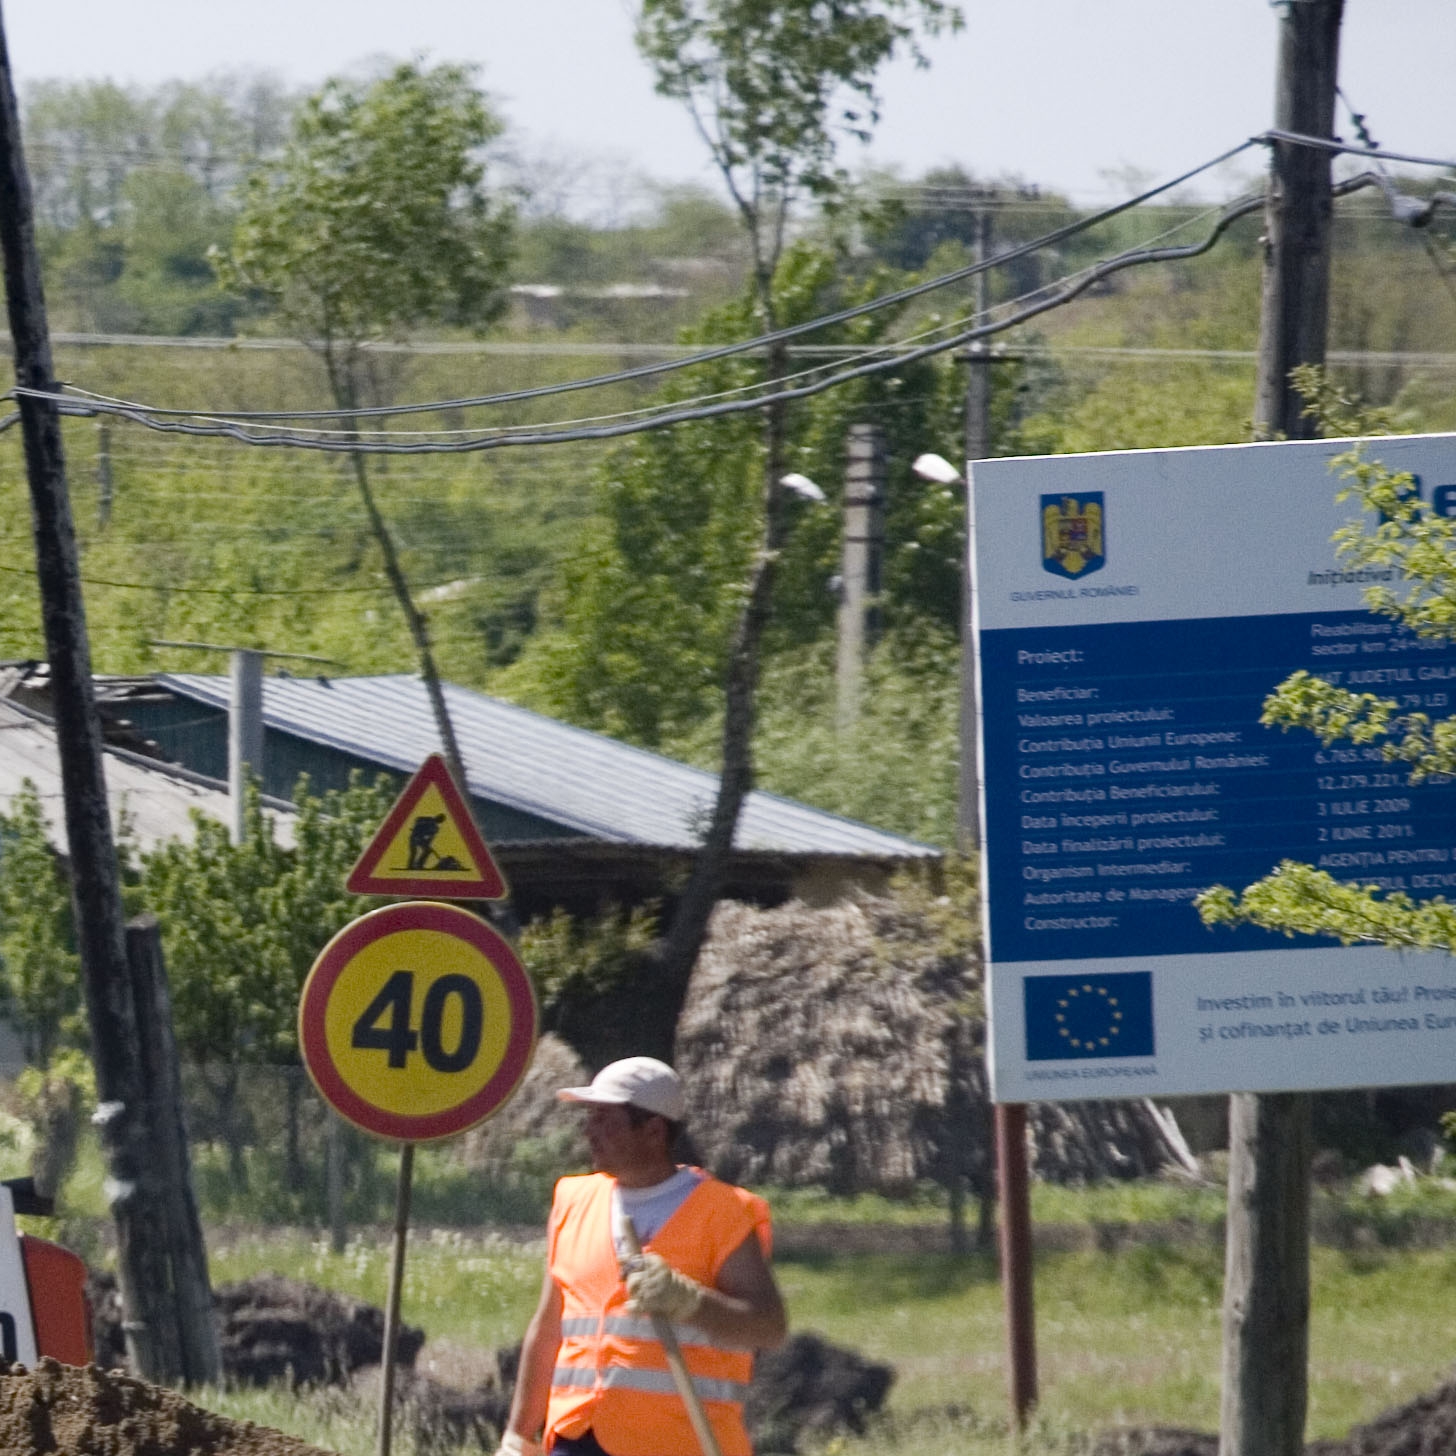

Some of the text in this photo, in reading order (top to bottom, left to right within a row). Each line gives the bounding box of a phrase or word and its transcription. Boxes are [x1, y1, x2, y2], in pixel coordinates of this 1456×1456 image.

[1010, 585, 1139, 602] GUVERNUL ROMÂNIEI
[1311, 622, 1392, 637] Reabilitare
[1016, 648, 1084, 665] Proiect:
[1312, 643, 1358, 656] sector
[1361, 641, 1386, 653] km
[1017, 687, 1099, 702] Beneficiar:
[1017, 708, 1175, 727] Valoarea proiectului:
[1108, 733, 1161, 749] Uniunii
[1165, 731, 1242, 747] Europene:
[1108, 758, 1191, 774] Guvernului
[1194, 753, 1269, 769] României:
[1109, 782, 1221, 800] Beneficiarului:
[1317, 798, 1410, 816] 3 IULIE 2009
[1021, 808, 1219, 829] Data începerii proiectului:
[1317, 827, 1328, 841] 2
[1331, 825, 1373, 841] IUNIE
[1022, 833, 1225, 855] Data finalizării proiectului:
[1387, 848, 1448, 864] PENTRU
[1022, 860, 1191, 882] Organism Intermediar:
[1024, 889, 1102, 905] Autoritate
[1105, 888, 1125, 902] de
[1024, 916, 1119, 930] Constructor:
[1197, 993, 1272, 1011] Investim
[1278, 991, 1295, 1007] în
[1300, 988, 1365, 1006] viitorul
[351, 970, 484, 1073] 40
[1316, 1018, 1340, 1036] de
[1345, 1016, 1419, 1033] Uniunea
